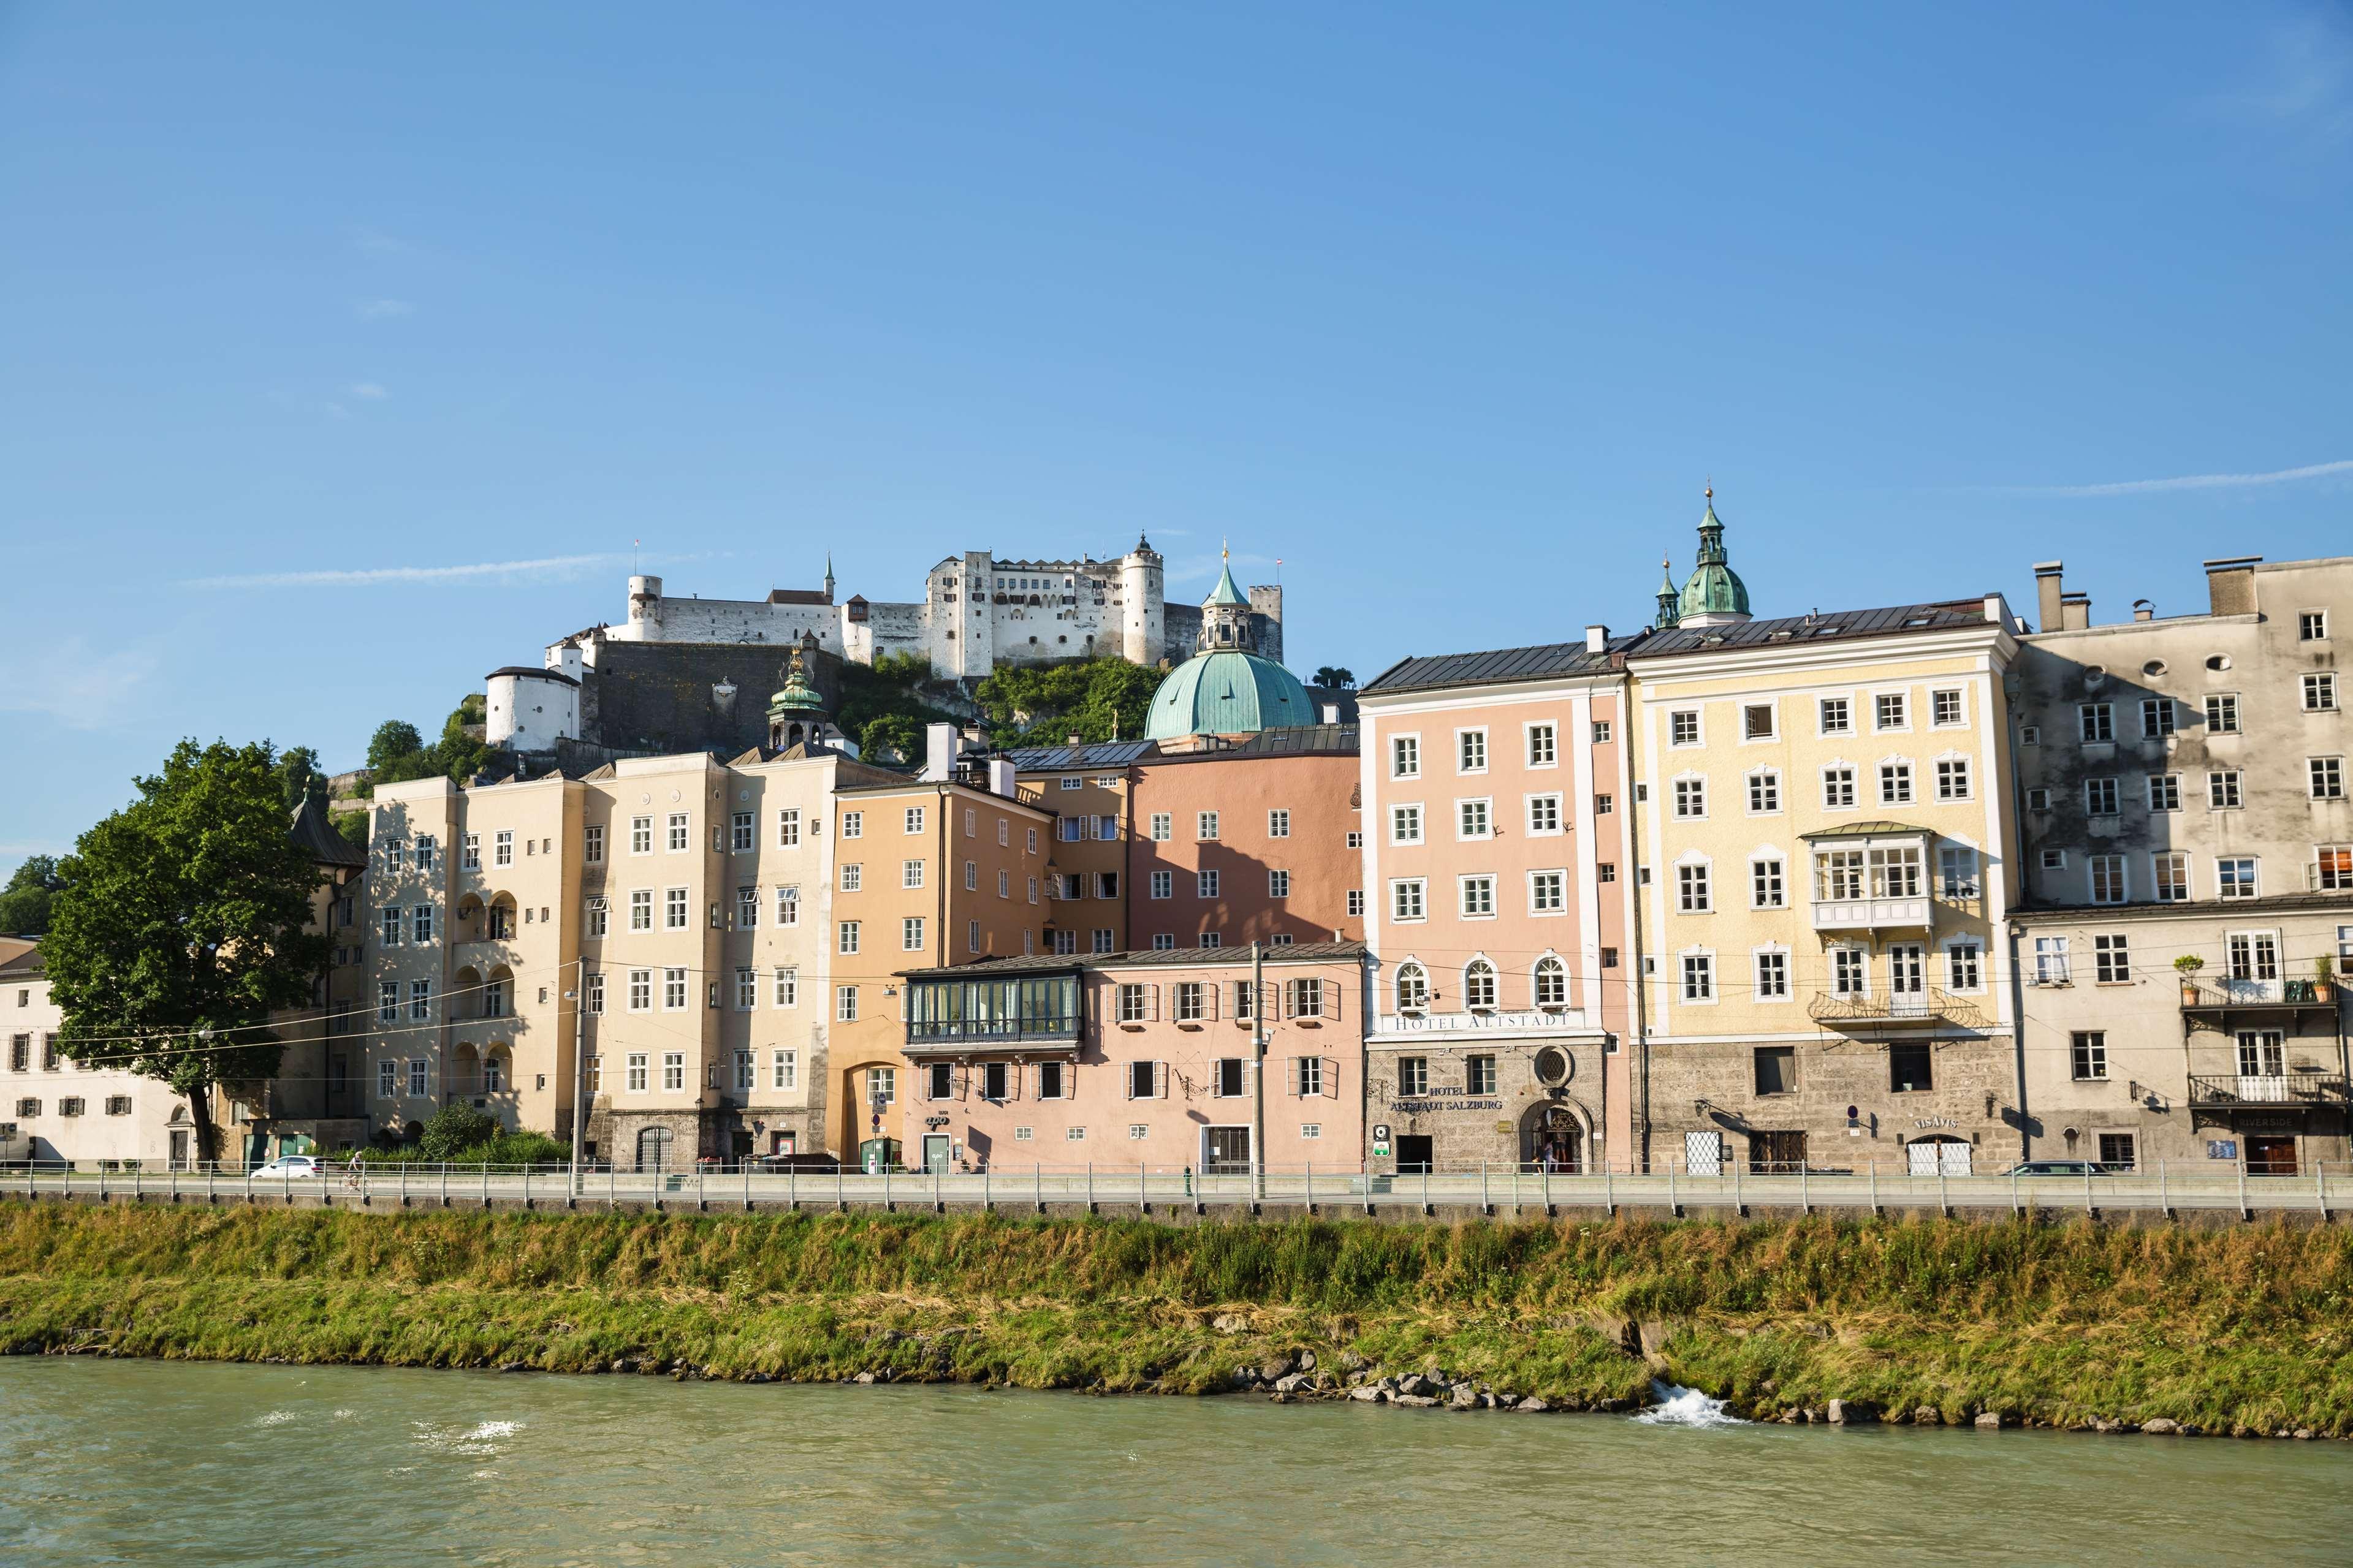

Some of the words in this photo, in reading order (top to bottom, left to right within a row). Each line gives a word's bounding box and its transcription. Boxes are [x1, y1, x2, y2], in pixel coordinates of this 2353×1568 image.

[1396, 1018, 1458, 1030] HOTEL
[1469, 1014, 1569, 1028] ALTSTADT
[1446, 1100, 1502, 1110] SALZBURG
[925, 1117, 948, 1131] apo
[2239, 1118, 2293, 1127] RIVERSIDE
